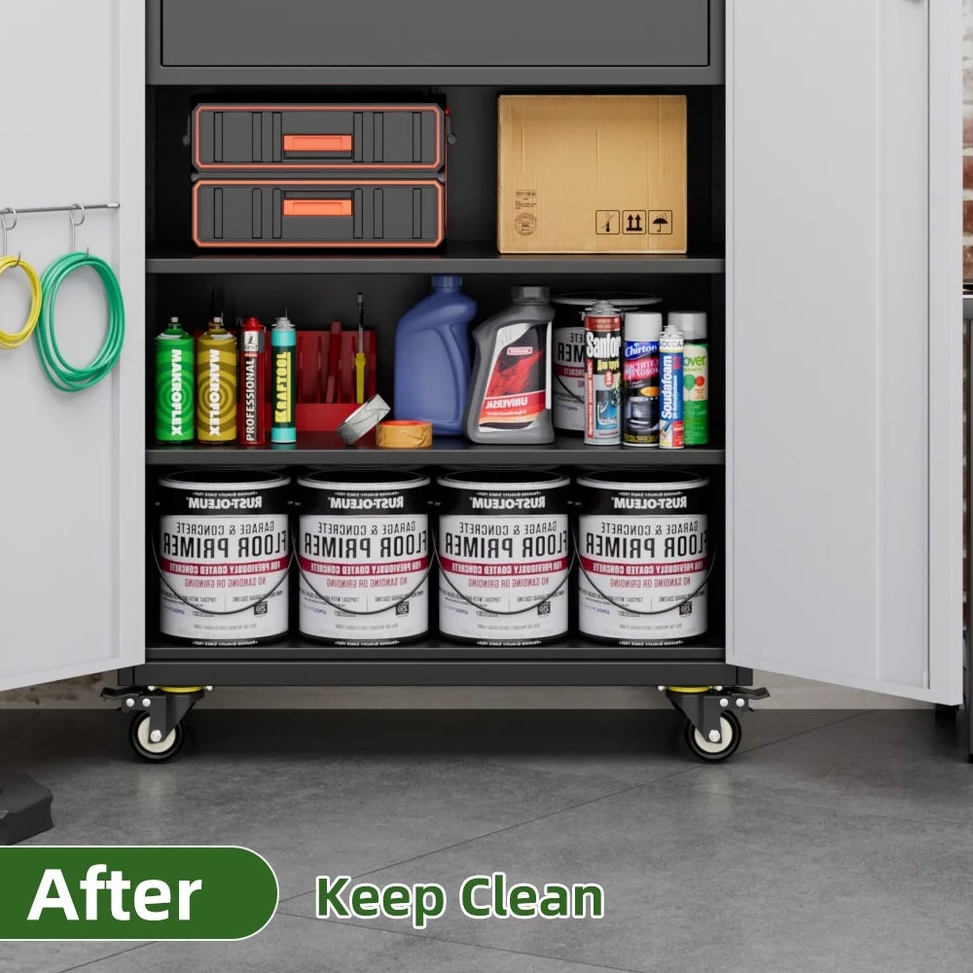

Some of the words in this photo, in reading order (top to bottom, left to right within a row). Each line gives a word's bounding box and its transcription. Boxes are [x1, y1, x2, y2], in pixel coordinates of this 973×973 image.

[586, 332, 621, 358] Sanfor
[625, 345, 658, 358] Chirton
[683, 355, 706, 366] over
[171, 349, 183, 436] MAKROFLEX
[209, 349, 220, 436] MAKROFLEX
[245, 358, 255, 442] PROFESSIONAL
[275, 351, 288, 423] KRAFTOOL
[661, 356, 672, 419] Soudafoam
